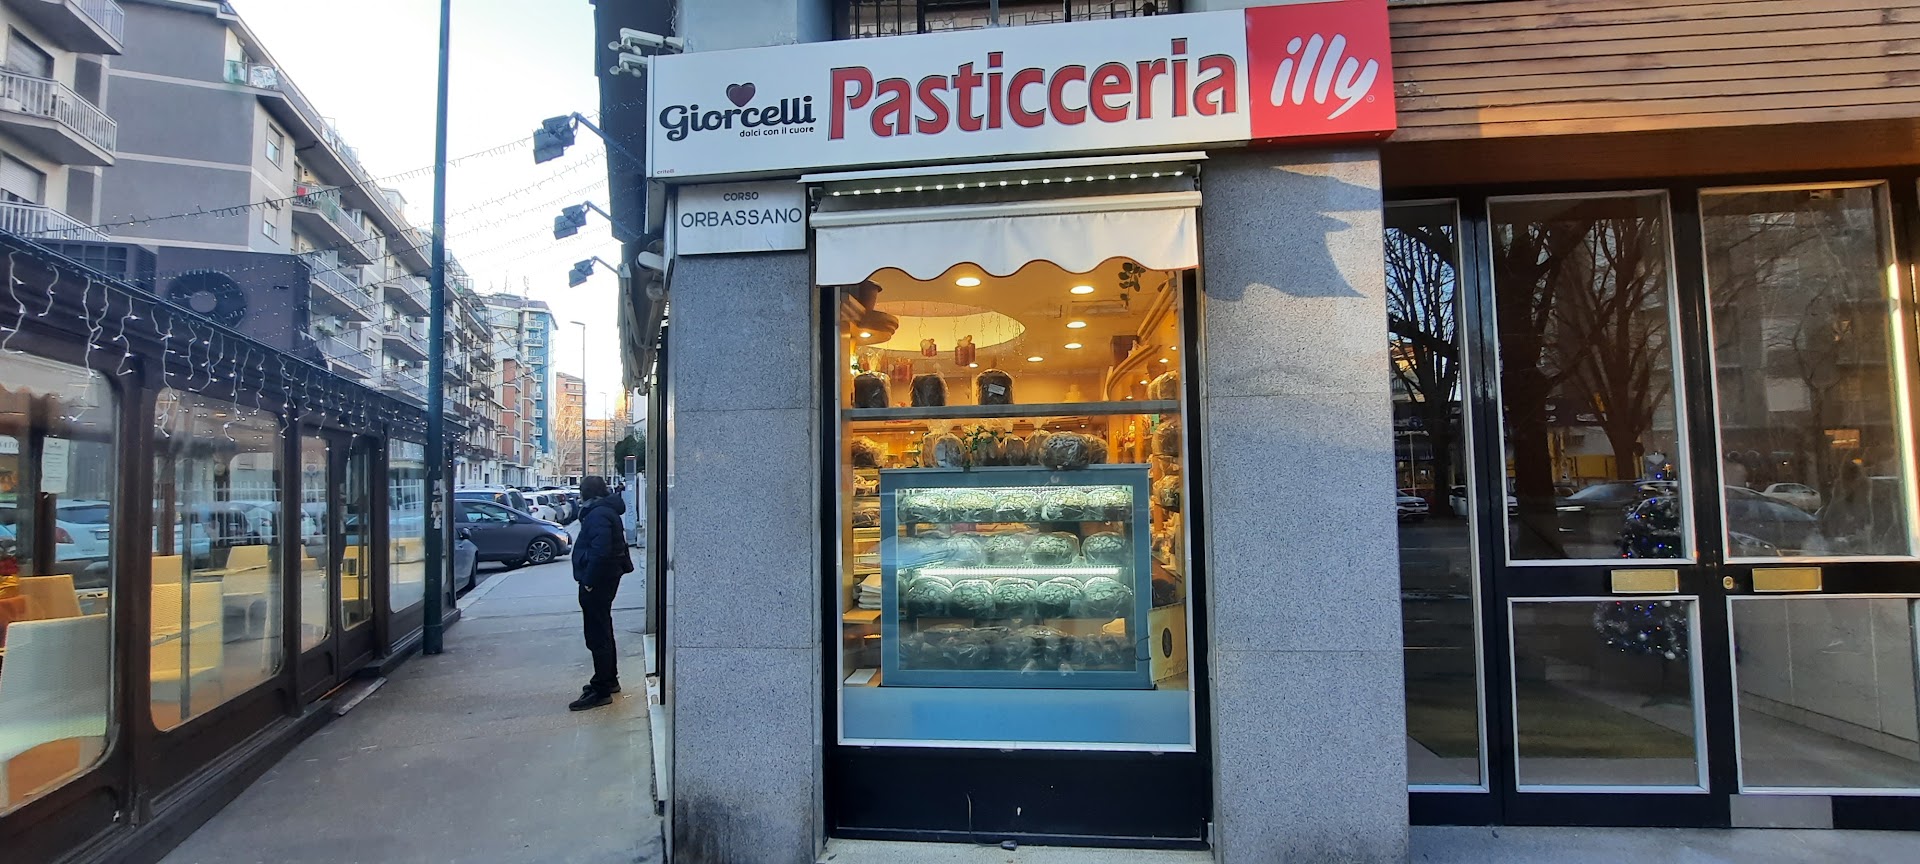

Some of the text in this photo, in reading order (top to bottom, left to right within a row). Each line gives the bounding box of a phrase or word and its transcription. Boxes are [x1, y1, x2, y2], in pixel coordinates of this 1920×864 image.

[828, 37, 1239, 141] Pasticceria
[1270, 33, 1379, 120] illy
[659, 95, 817, 142] Giorcelli
[739, 126, 815, 138] dolci con il cuore
[723, 191, 759, 202] CORSO
[681, 207, 802, 228] ORBASSANO
